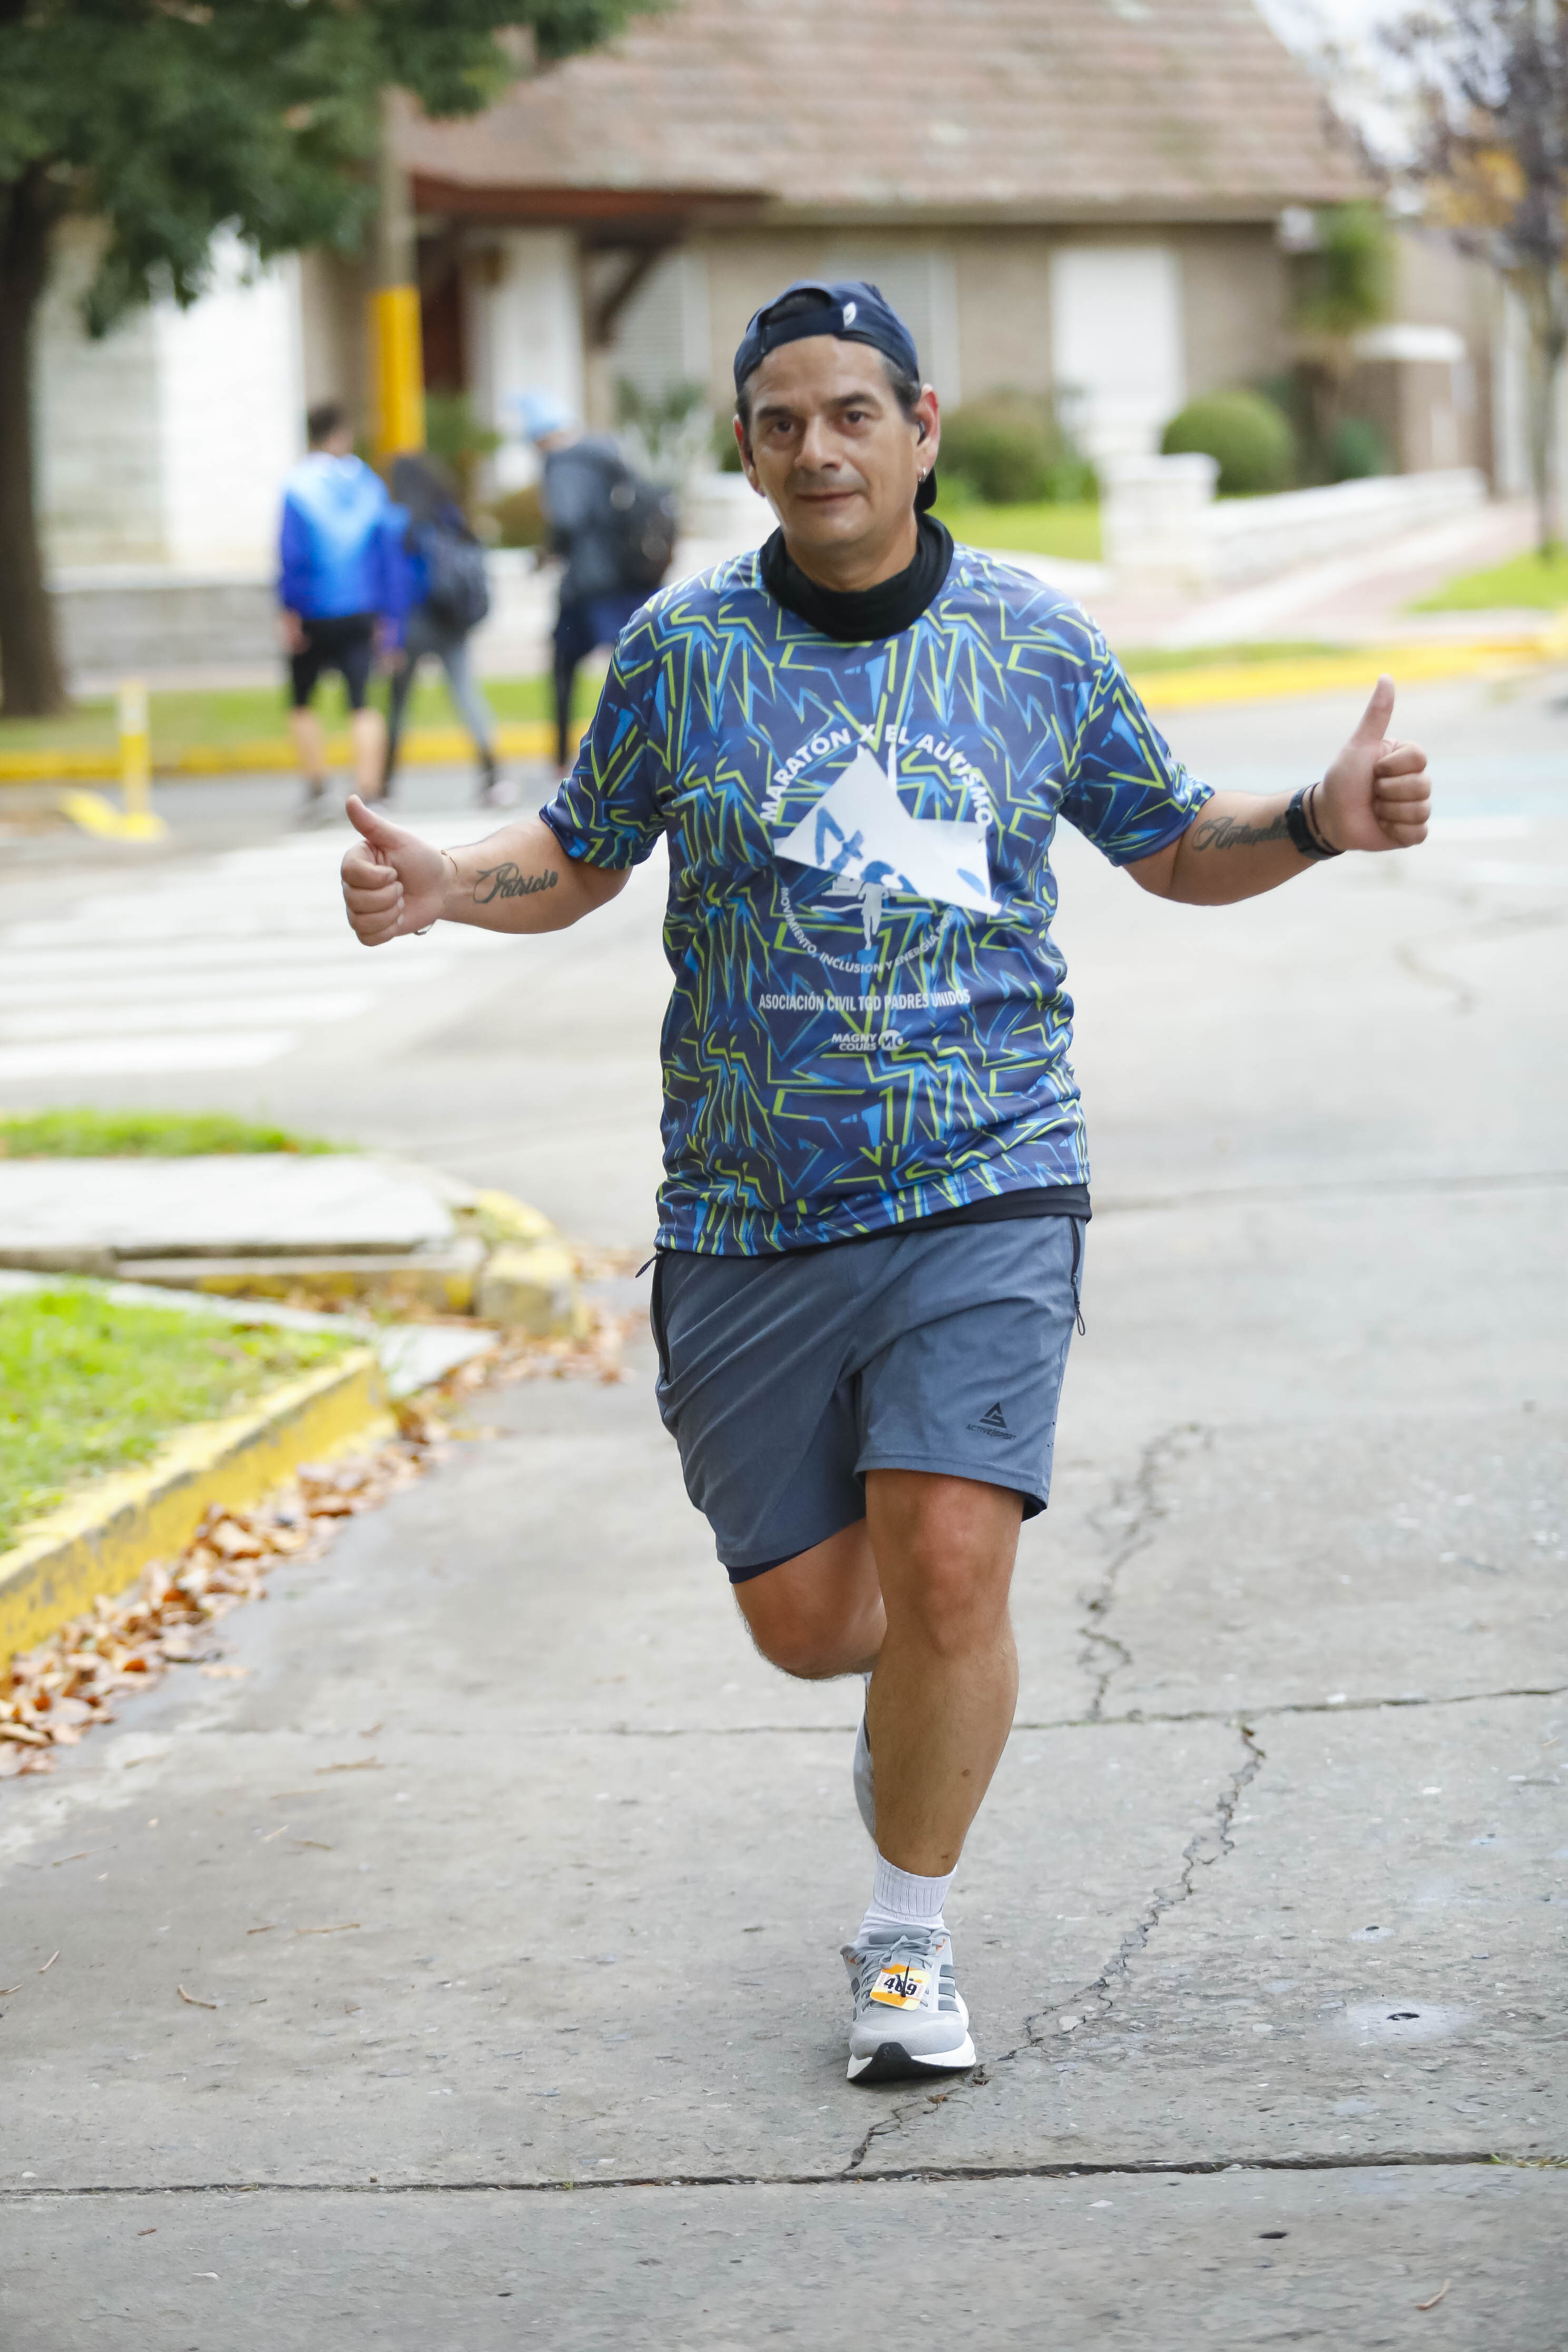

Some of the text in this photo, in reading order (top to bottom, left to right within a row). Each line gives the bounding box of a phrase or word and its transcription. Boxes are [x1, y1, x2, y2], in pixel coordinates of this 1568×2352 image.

[760, 724, 994, 828] MARATÓN X EL AUTISMO
[759, 991, 824, 1011] ASOCIACIÓN
[827, 995, 857, 1012] CIVIL
[884, 993, 928, 1010] PADRES
[931, 988, 971, 1006] UNIDOS
[831, 1033, 878, 1042] MAGNY
[839, 1042, 877, 1051] COURS
